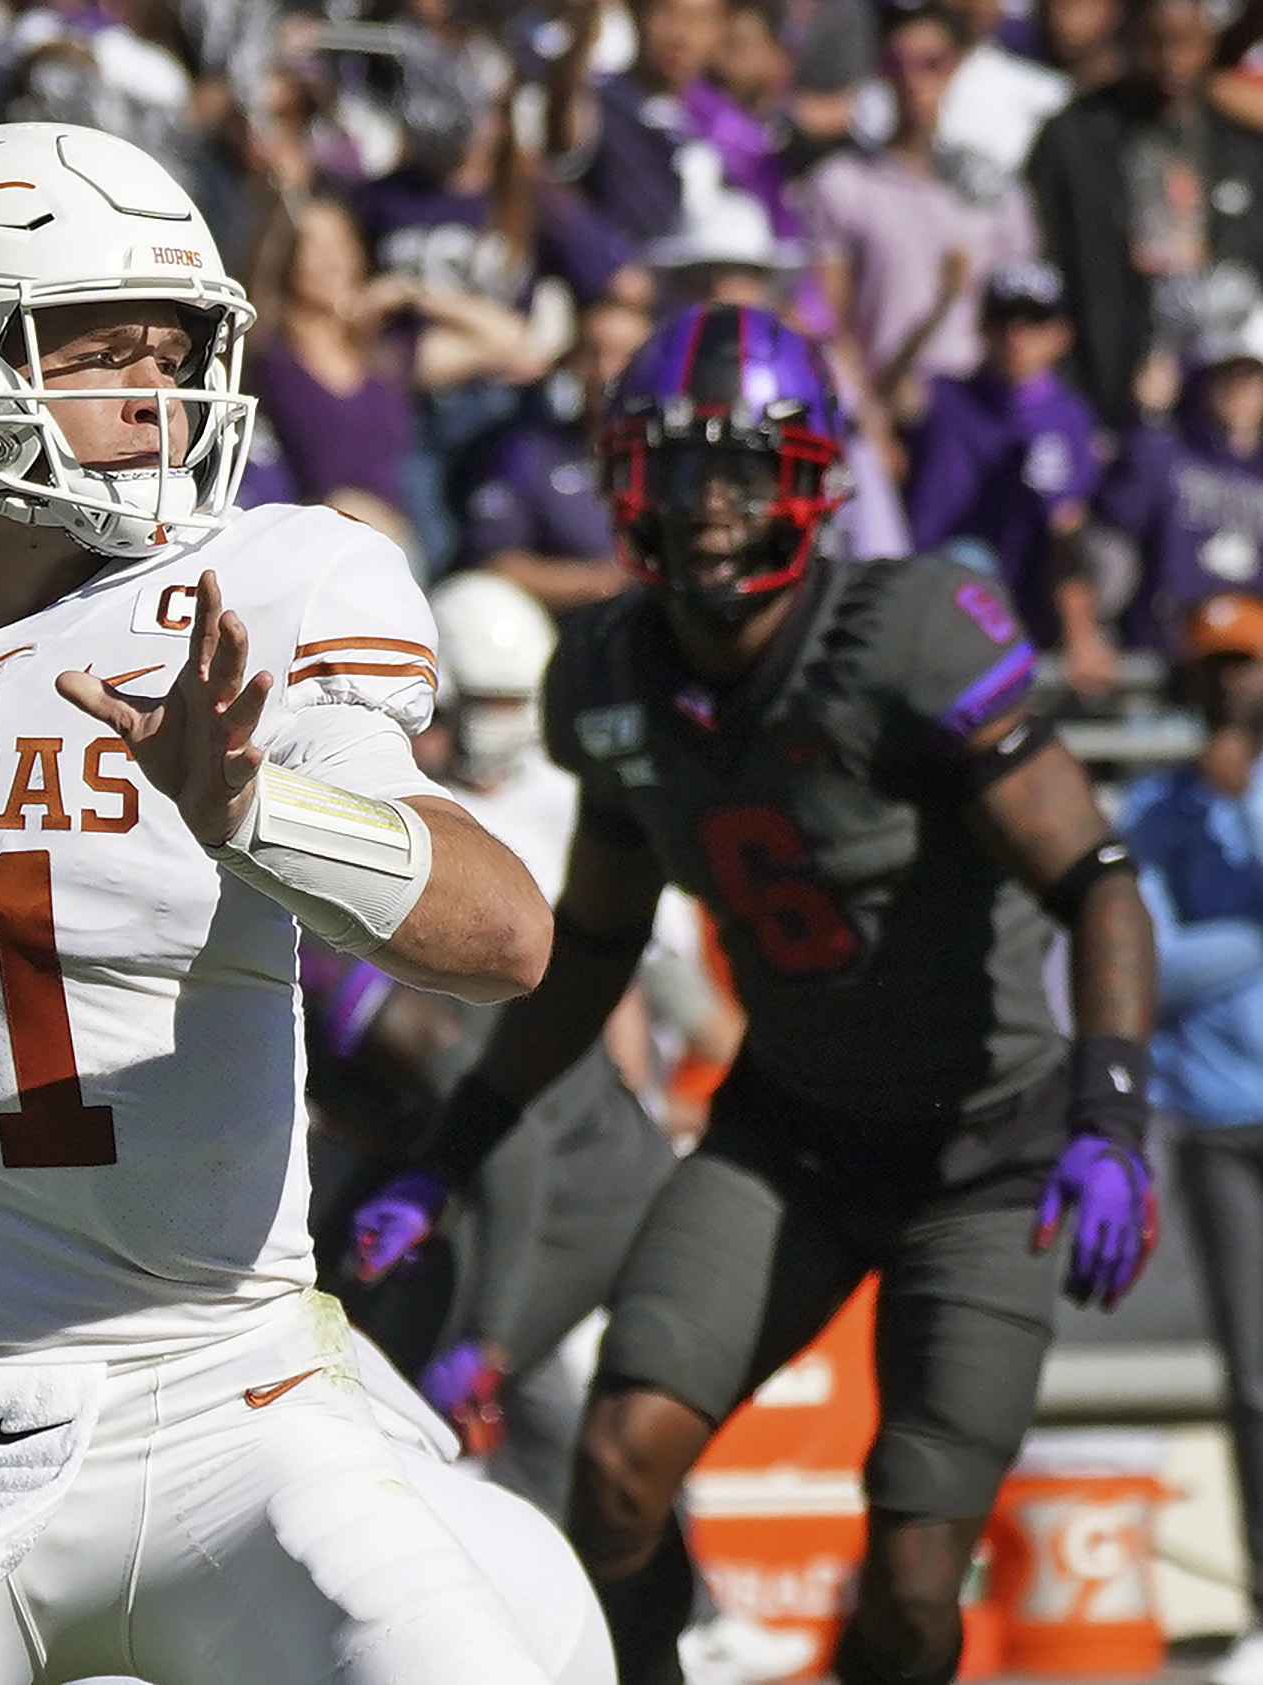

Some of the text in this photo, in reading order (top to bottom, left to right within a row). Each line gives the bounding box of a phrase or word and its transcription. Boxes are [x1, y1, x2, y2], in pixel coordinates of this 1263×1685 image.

[150, 246, 203, 269] HORNS
[156, 585, 197, 631] C
[700, 804, 858, 972] 6
